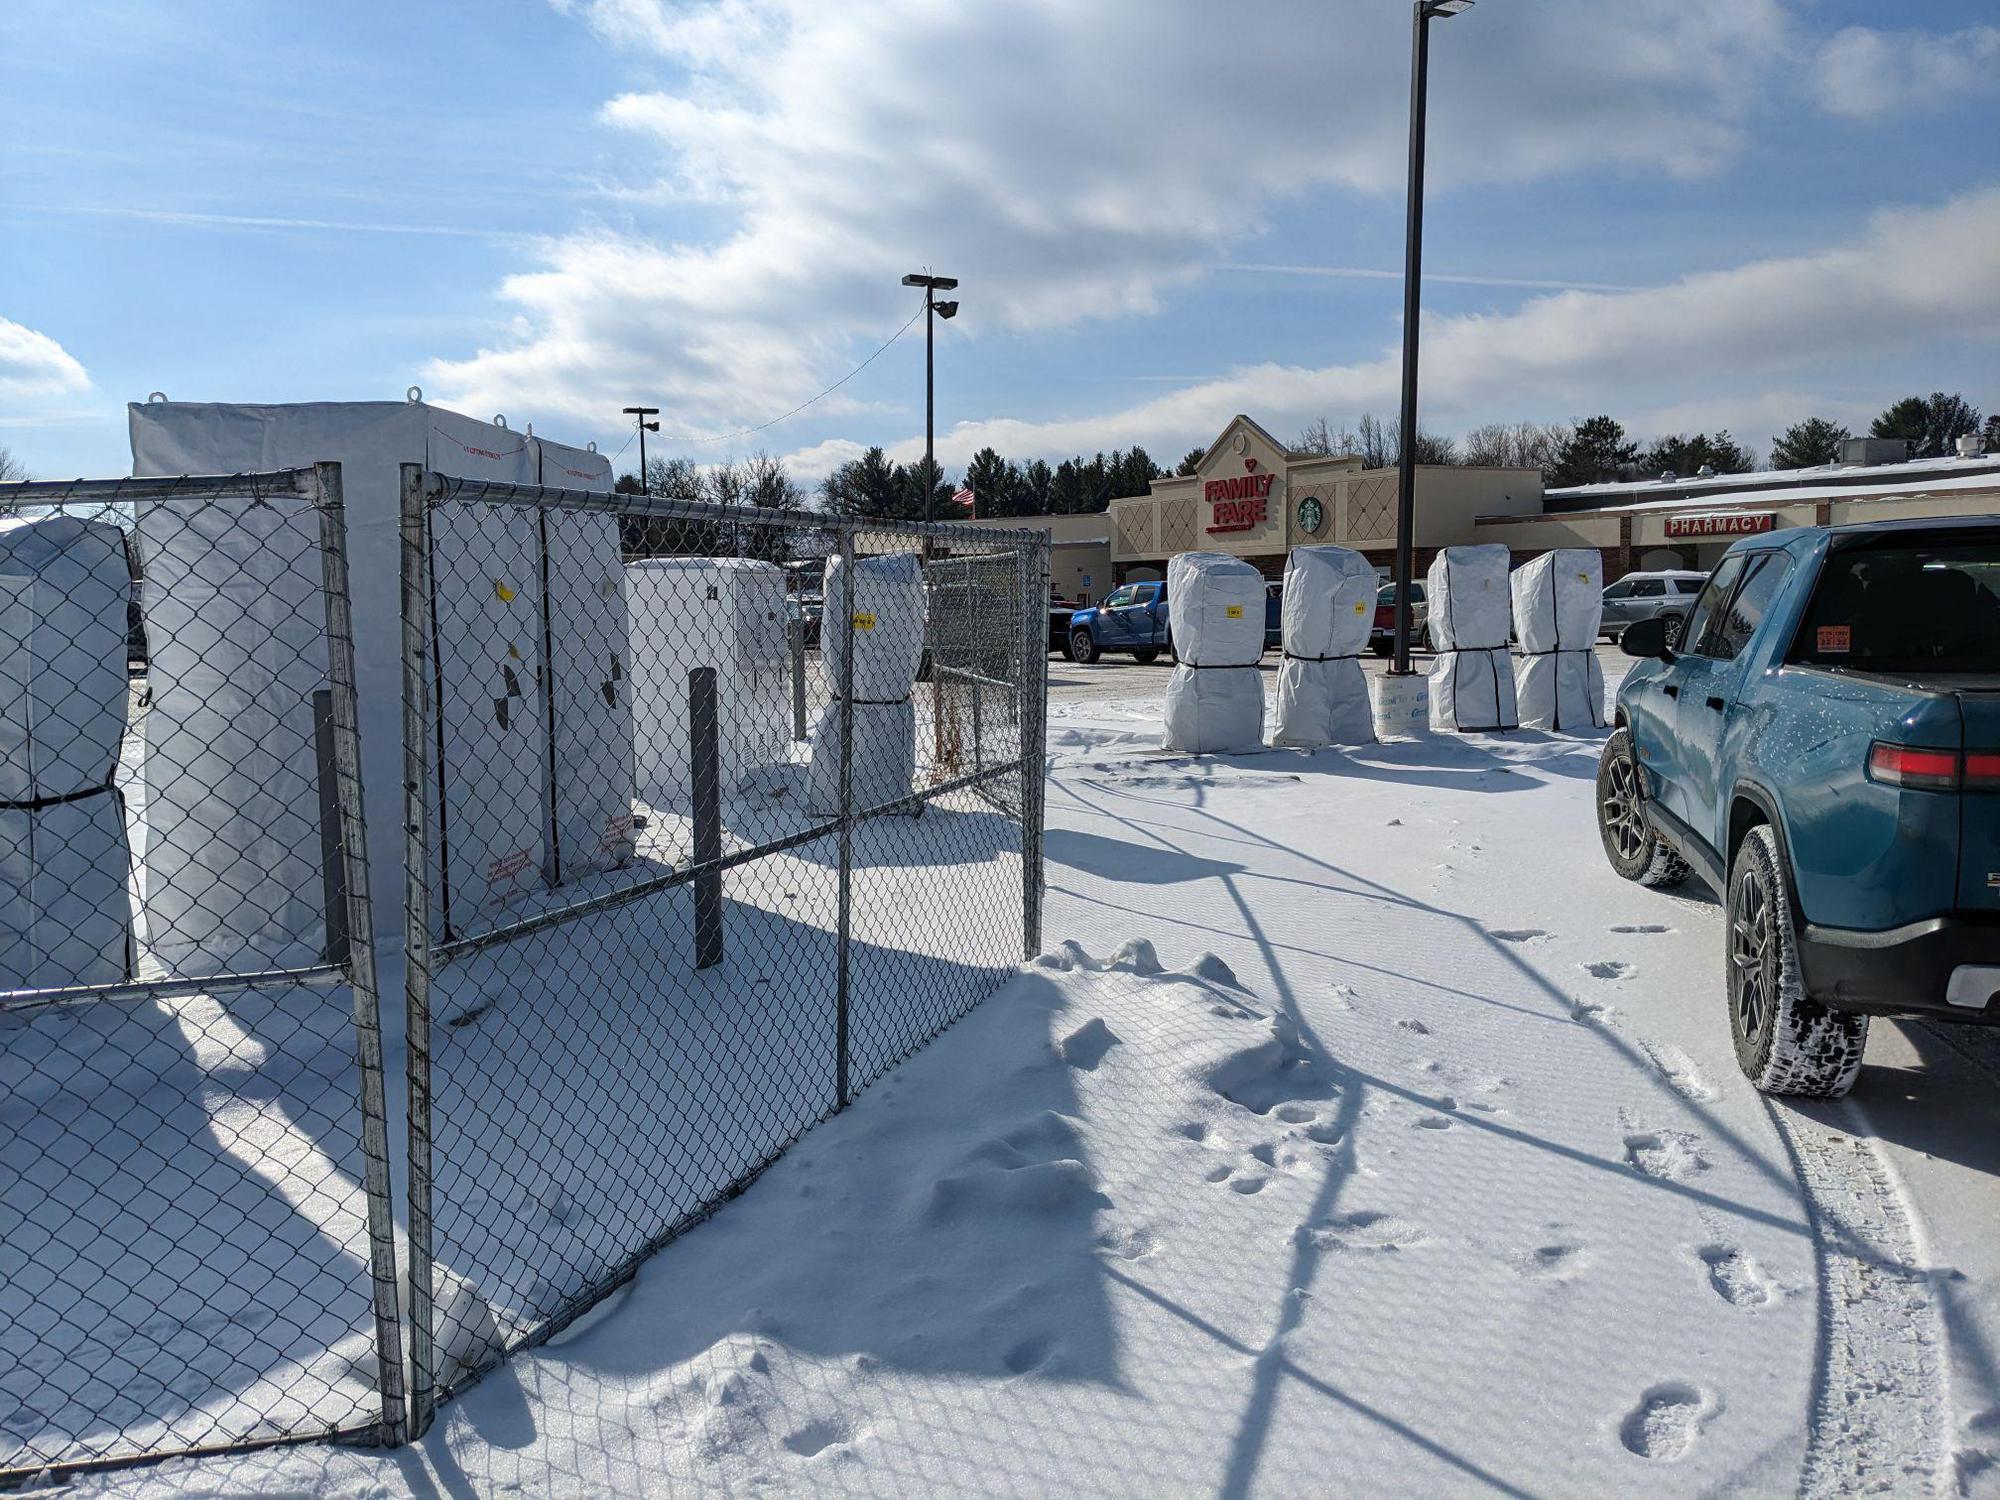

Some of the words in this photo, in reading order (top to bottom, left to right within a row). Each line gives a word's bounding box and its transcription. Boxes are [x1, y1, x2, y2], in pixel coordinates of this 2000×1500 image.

[1205, 474, 1275, 502] FAMILY
[1213, 499, 1267, 525] FARE
[1670, 516, 1764, 533] PHARMACY
